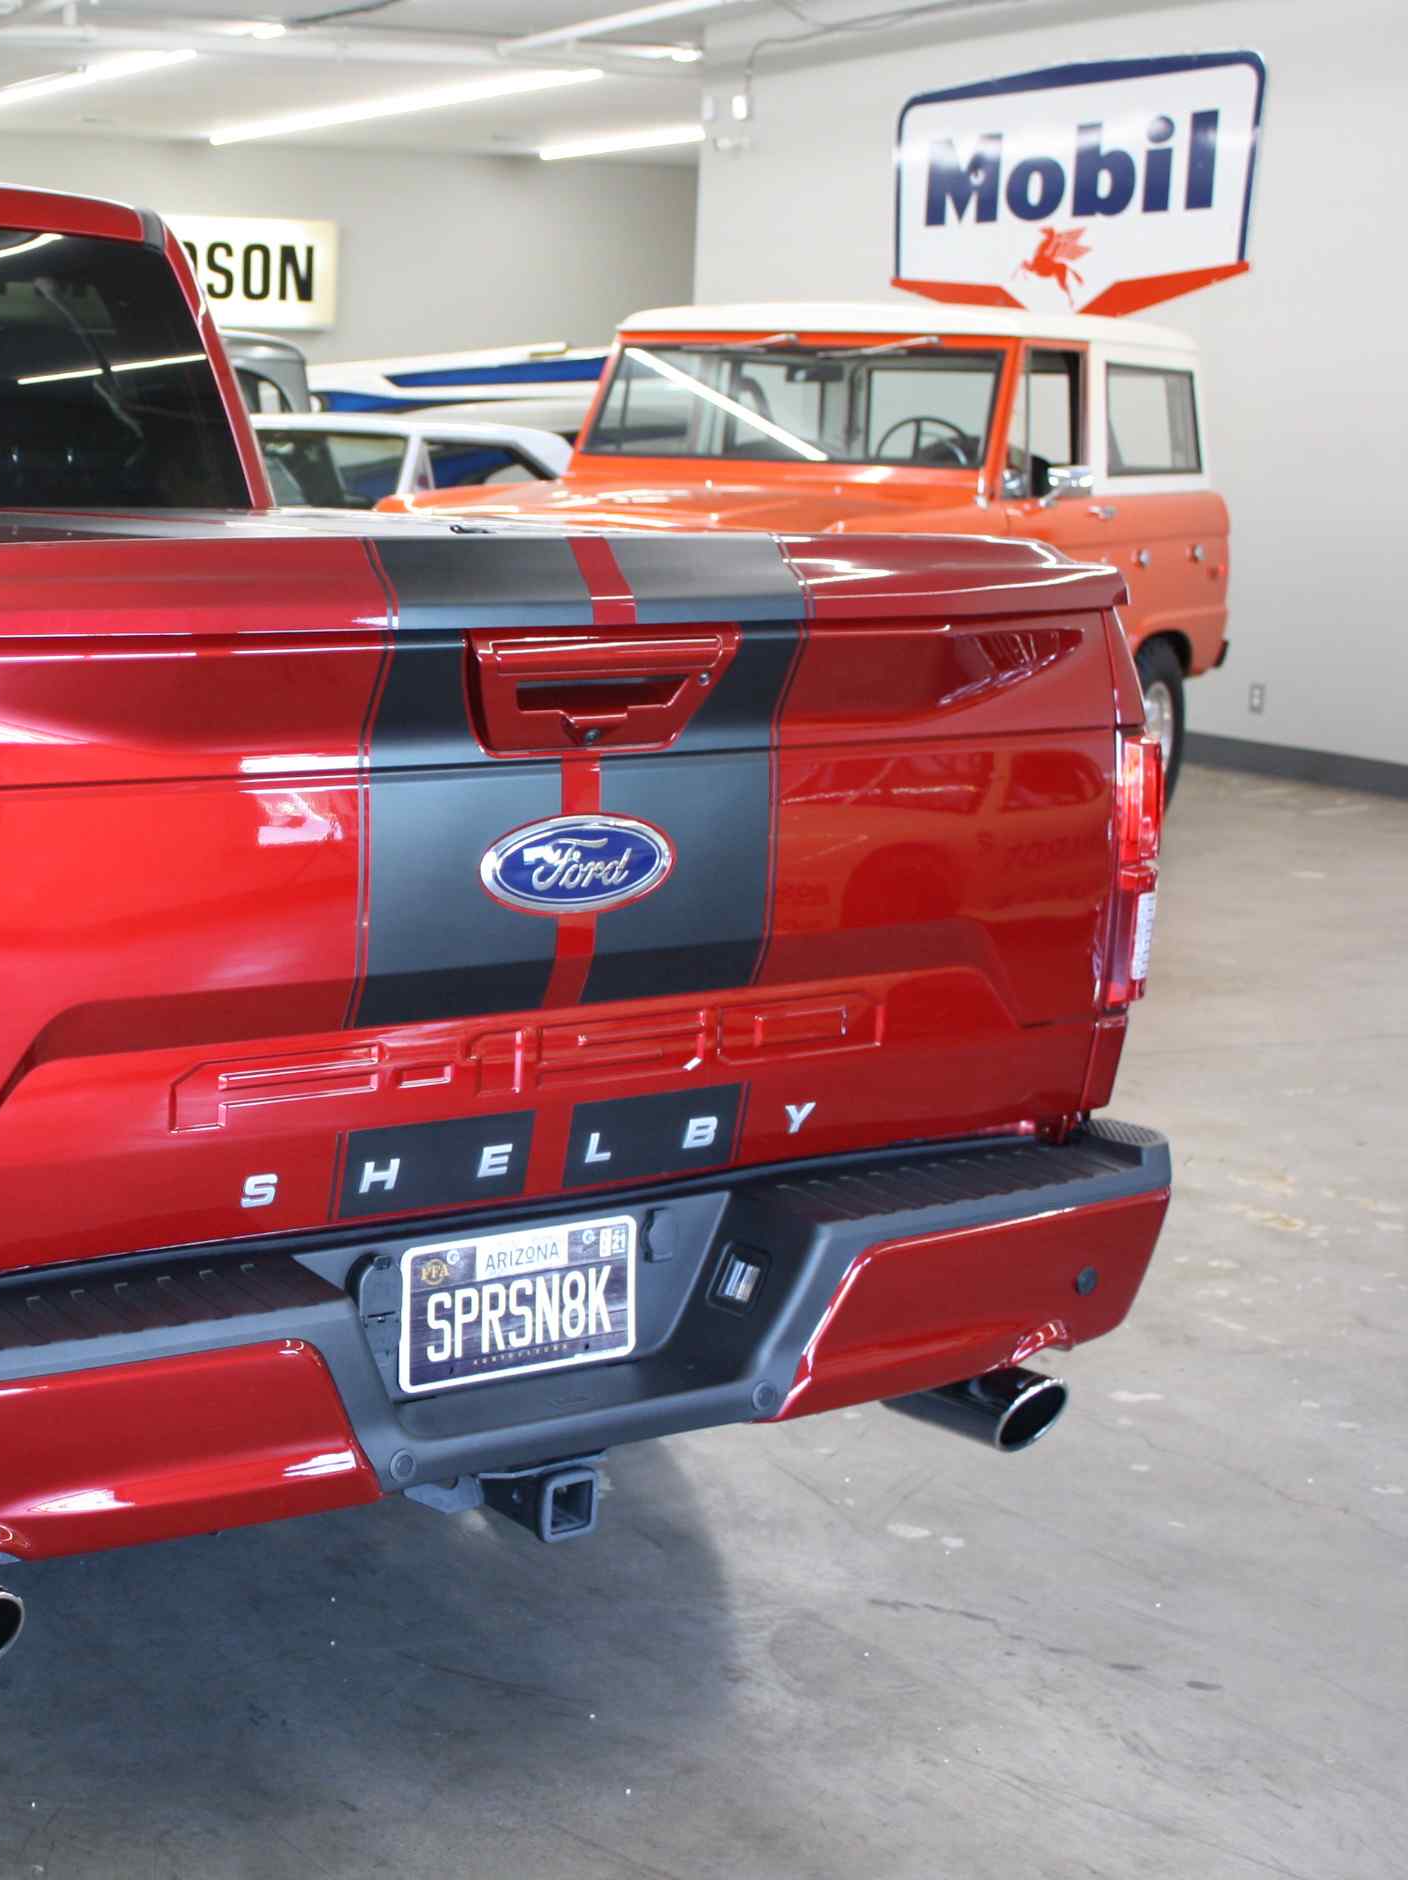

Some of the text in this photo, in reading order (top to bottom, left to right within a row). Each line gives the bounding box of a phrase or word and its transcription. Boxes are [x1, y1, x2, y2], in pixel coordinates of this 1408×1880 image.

[925, 109, 1219, 226] Mobil
[524, 838, 632, 890] Ford
[241, 1101, 816, 1208] SHELBY
[485, 1241, 560, 1272] ARIZONA
[426, 1265, 612, 1362] SPRSN8K
